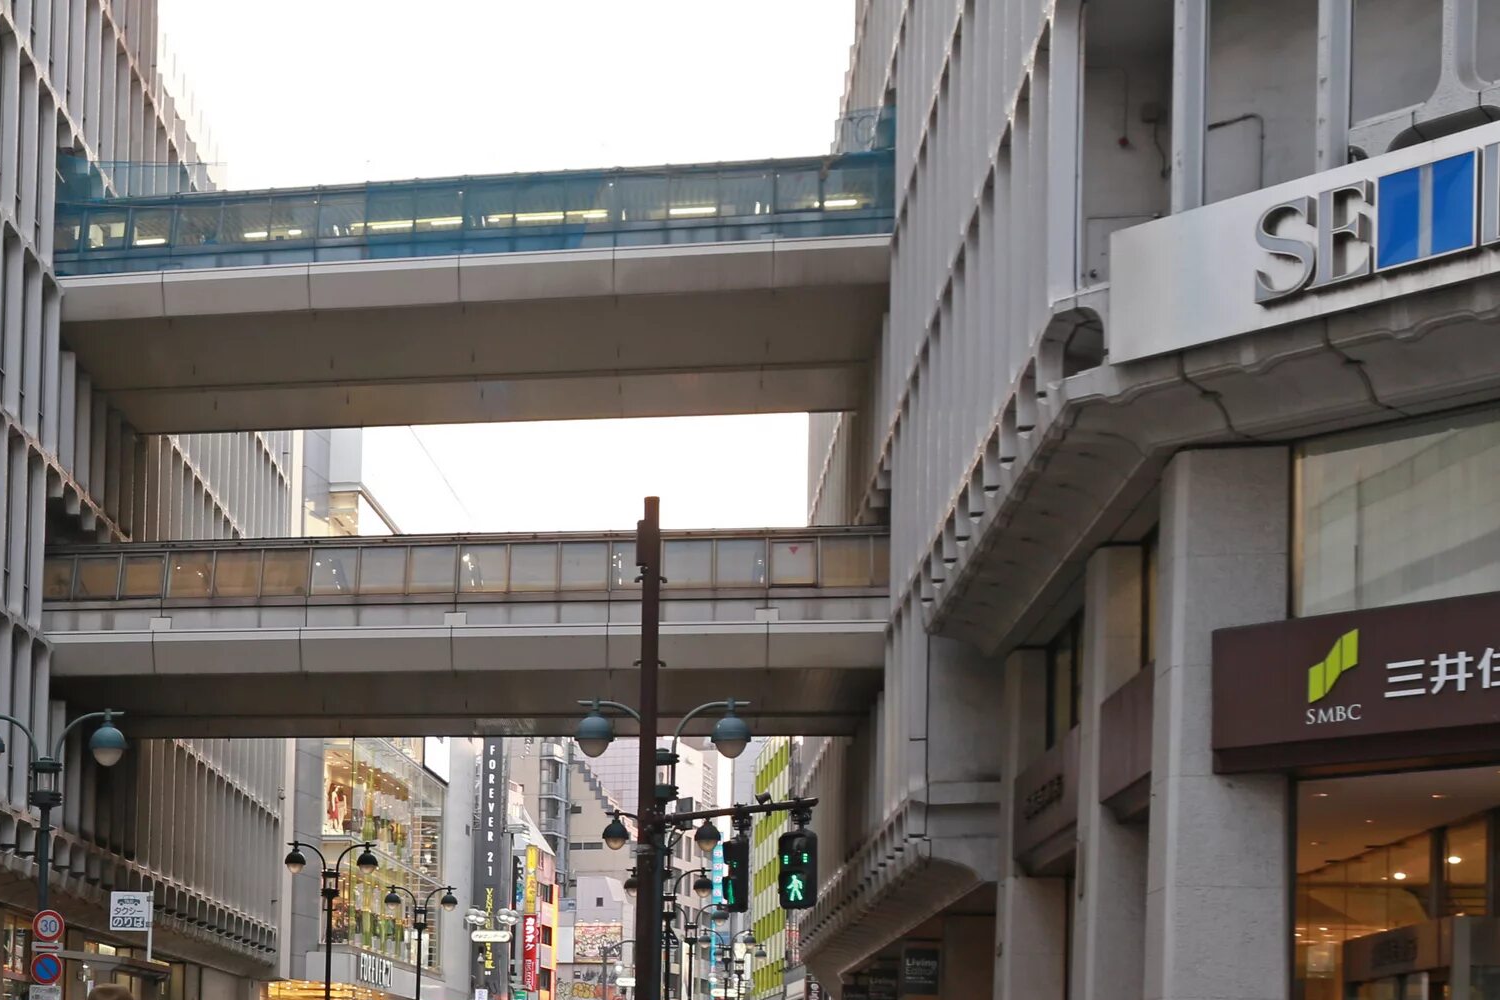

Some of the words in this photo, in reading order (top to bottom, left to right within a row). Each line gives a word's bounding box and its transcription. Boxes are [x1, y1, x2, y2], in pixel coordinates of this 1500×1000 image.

[1255, 142, 1500, 304] SEI
[1305, 703, 1362, 725] SMBC
[487, 745, 496, 842] FOREVER
[487, 851, 495, 877] 21
[113, 907, 144, 915] タクシー
[40, 919, 58, 933] 30
[112, 917, 145, 928] のりば
[525, 917, 535, 952] カラオケ
[906, 958, 938, 971] Living
